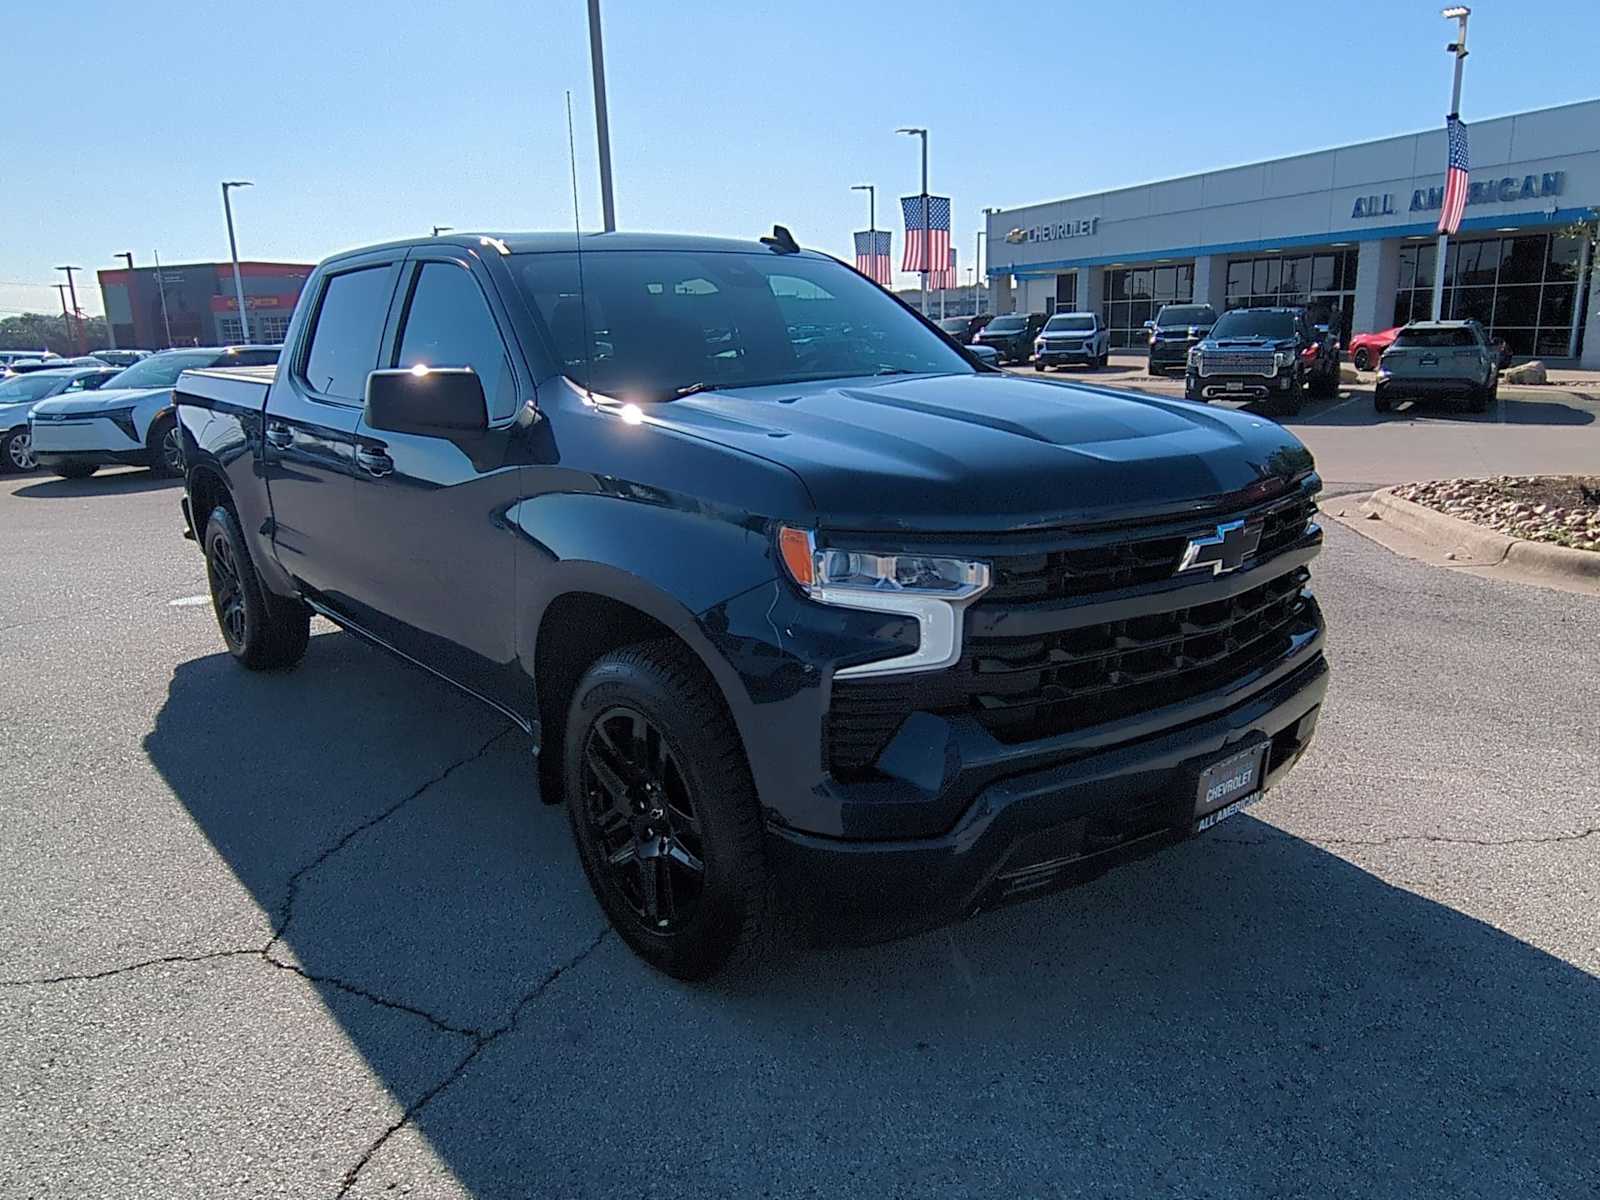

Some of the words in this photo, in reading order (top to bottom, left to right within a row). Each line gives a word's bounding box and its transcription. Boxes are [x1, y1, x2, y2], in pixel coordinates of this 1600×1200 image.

[1352, 194, 1398, 218] ALL
[1409, 172, 1566, 212] AMRICAN
[1027, 216, 1100, 242] CHEVROLET
[1206, 769, 1252, 802] CHEVROLET
[1198, 815, 1216, 832] ALL
